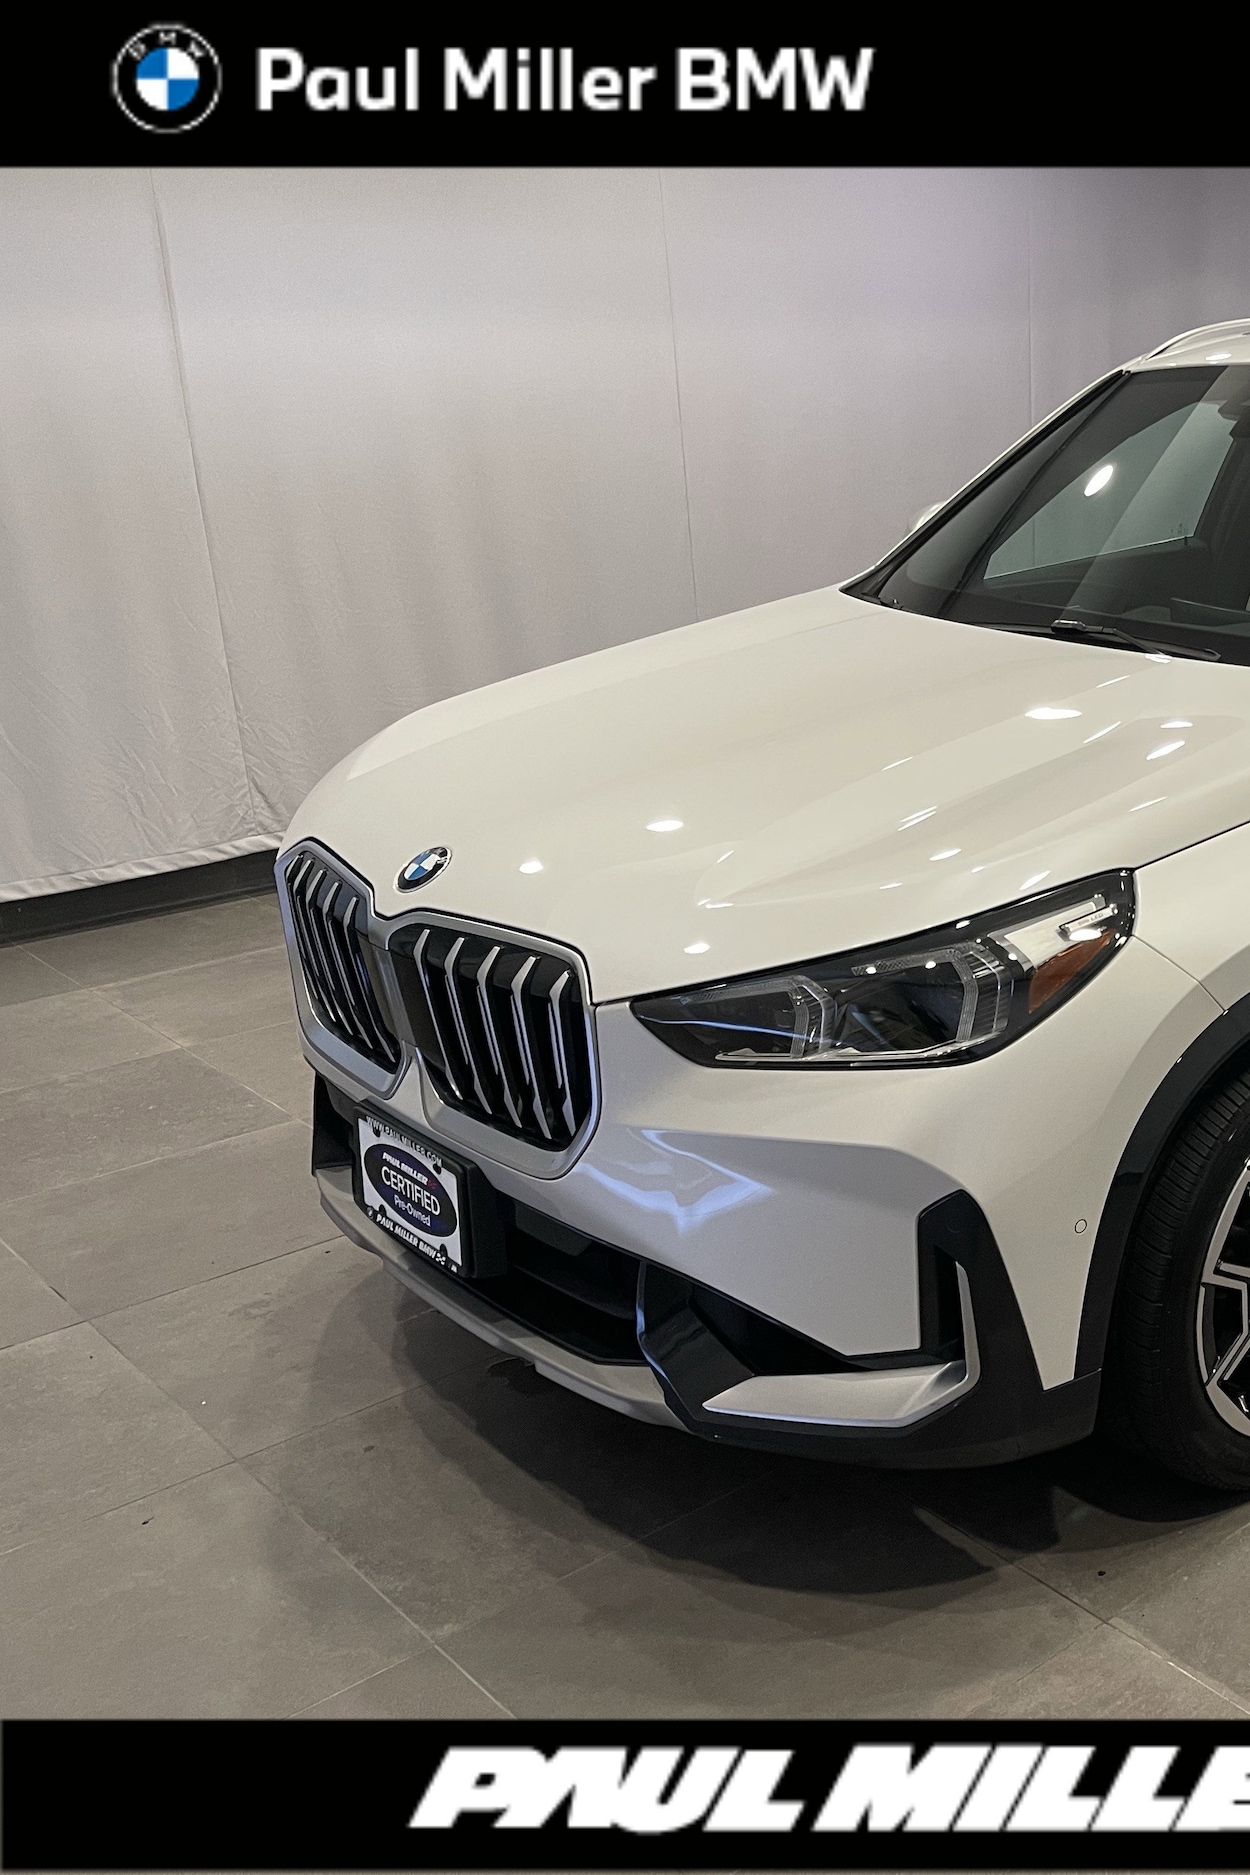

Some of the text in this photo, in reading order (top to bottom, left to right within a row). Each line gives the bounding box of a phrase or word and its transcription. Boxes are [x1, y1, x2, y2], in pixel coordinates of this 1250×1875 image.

[382, 1152, 429, 1186] PAUL MILLER
[381, 1166, 441, 1216] CERTIFIED
[394, 1194, 431, 1227] Pre-Owned
[376, 1211, 437, 1259] PAUL MILLER BMW
